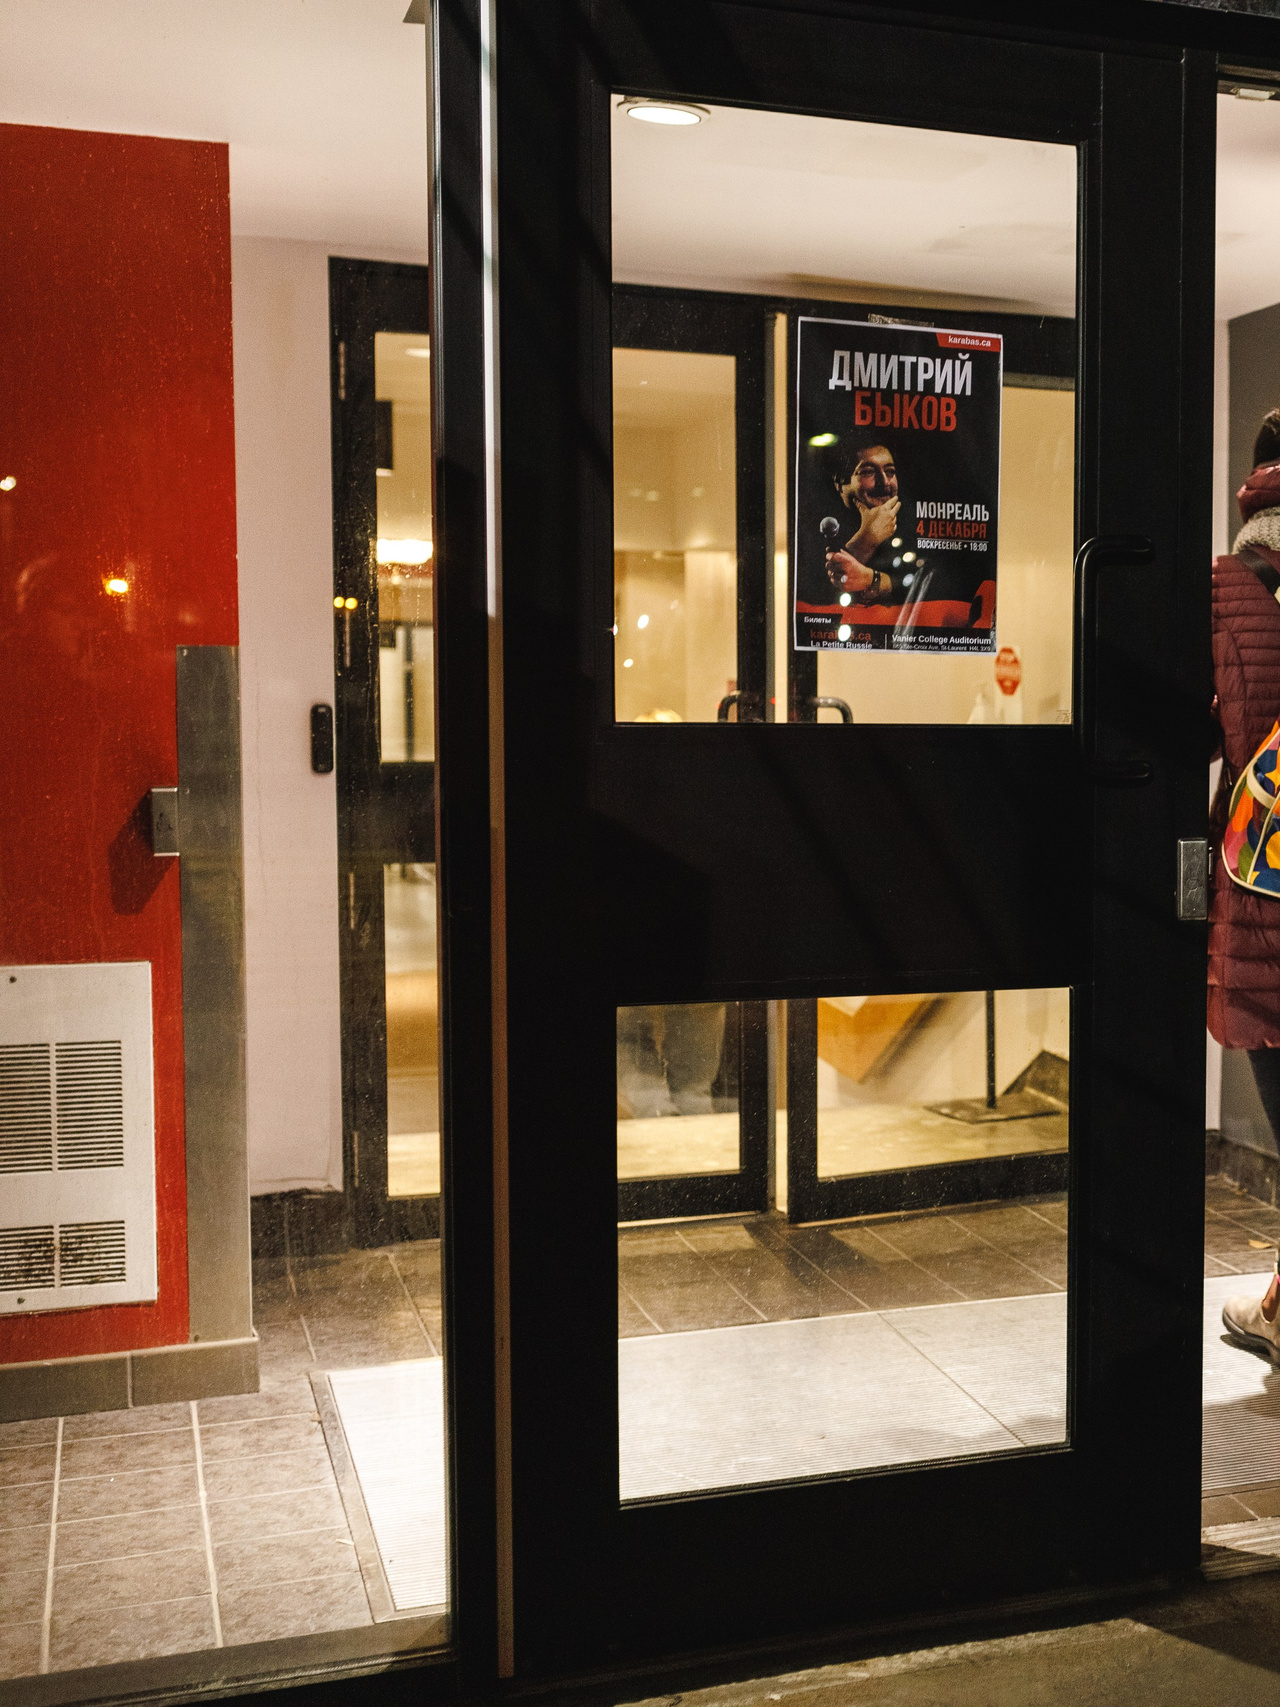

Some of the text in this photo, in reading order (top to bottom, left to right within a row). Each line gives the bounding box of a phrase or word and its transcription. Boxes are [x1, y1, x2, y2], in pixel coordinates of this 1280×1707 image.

[948, 335, 992, 347] karabas.ca
[828, 350, 973, 396] ДМИТРИЙ
[854, 390, 957, 432] БЫКОВ
[916, 501, 990, 522] МОНРЕАЛЬ
[916, 520, 988, 540] 4 ДЕКАБРЯ
[917, 540, 988, 552] ВОСКРЕСЕНЬЕ 18:00
[803, 615, 832, 624] Билеты
[810, 640, 873, 650] La Petite Russie
[892, 634, 992, 645] Vanier College Auditorium
